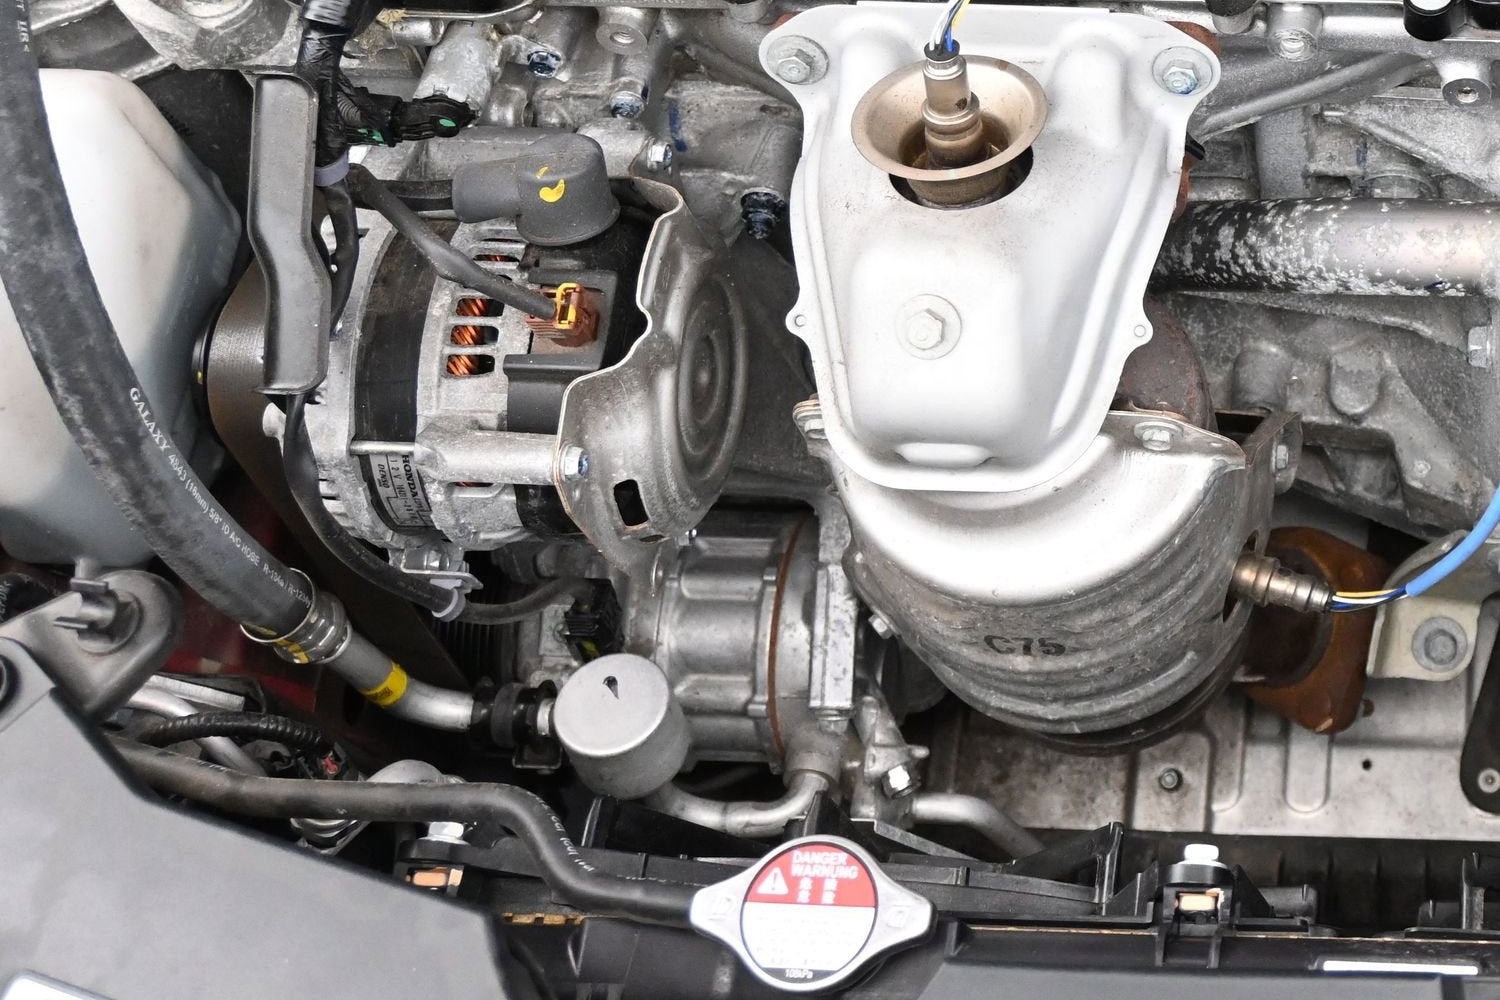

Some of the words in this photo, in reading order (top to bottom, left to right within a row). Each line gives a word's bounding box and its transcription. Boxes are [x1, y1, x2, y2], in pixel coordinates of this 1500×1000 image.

[129, 387, 171, 453] GALAXY
[166, 451, 189, 482] 4843
[184, 477, 211, 515] (16mm)
[377, 463, 389, 488] DENSO
[401, 454, 418, 498] HONDA
[792, 850, 848, 865] DANGER
[791, 863, 859, 880] WARNUNG
